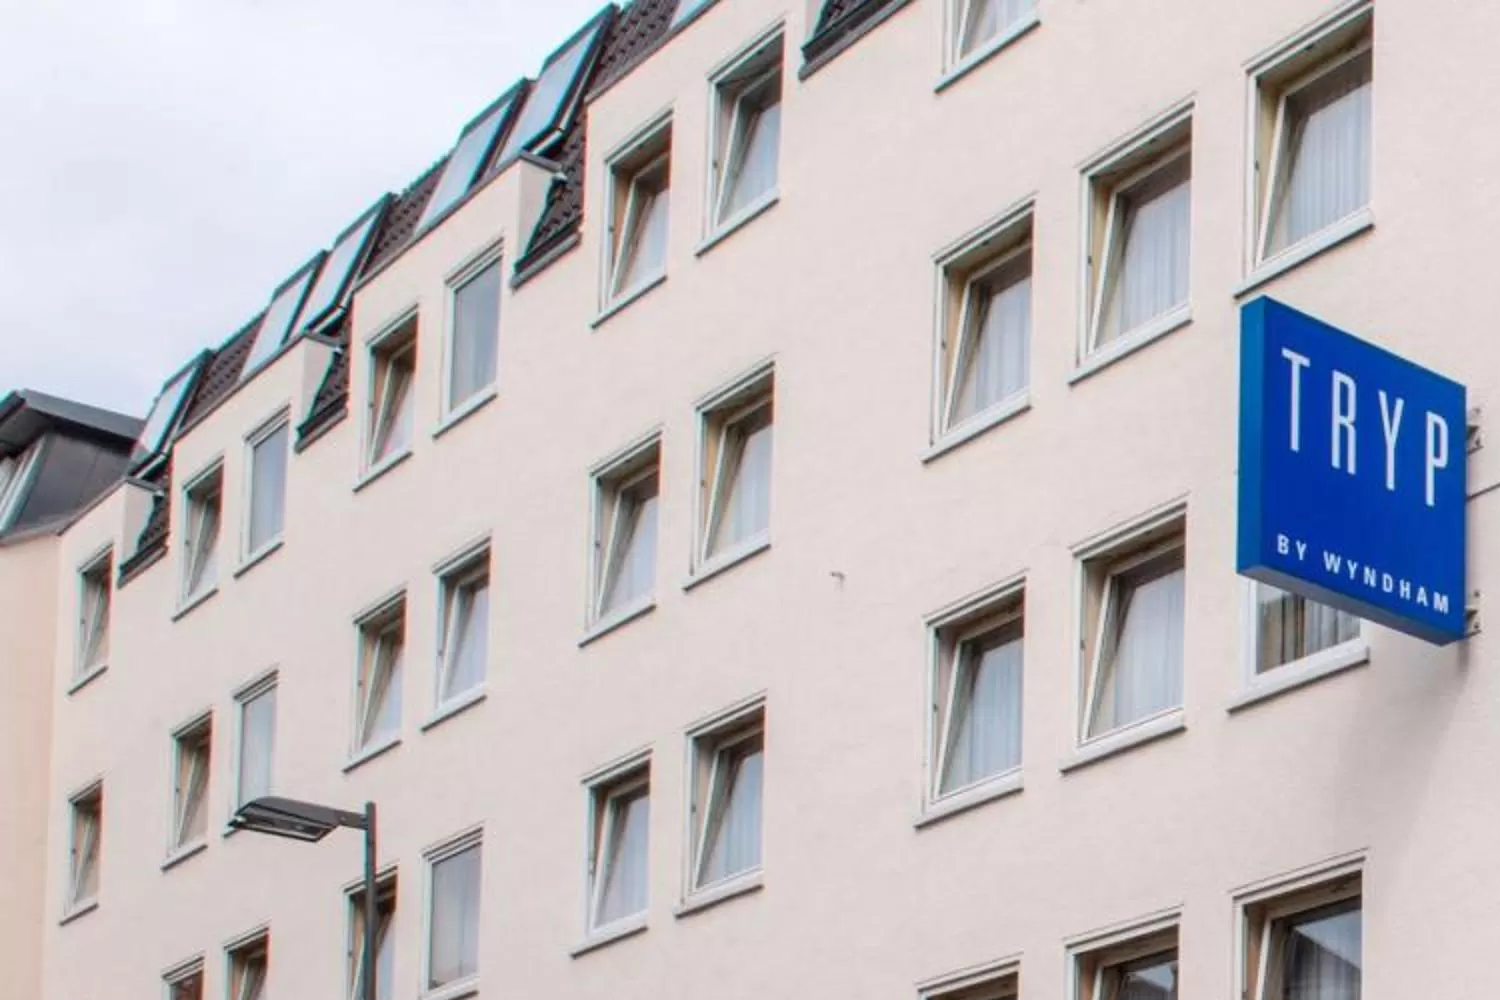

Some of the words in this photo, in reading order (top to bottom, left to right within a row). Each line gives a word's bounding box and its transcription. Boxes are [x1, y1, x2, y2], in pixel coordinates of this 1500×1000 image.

[1282, 349, 1448, 506] TRYP
[1277, 534, 1307, 560] BY
[1323, 550, 1449, 614] WYNDHAM
